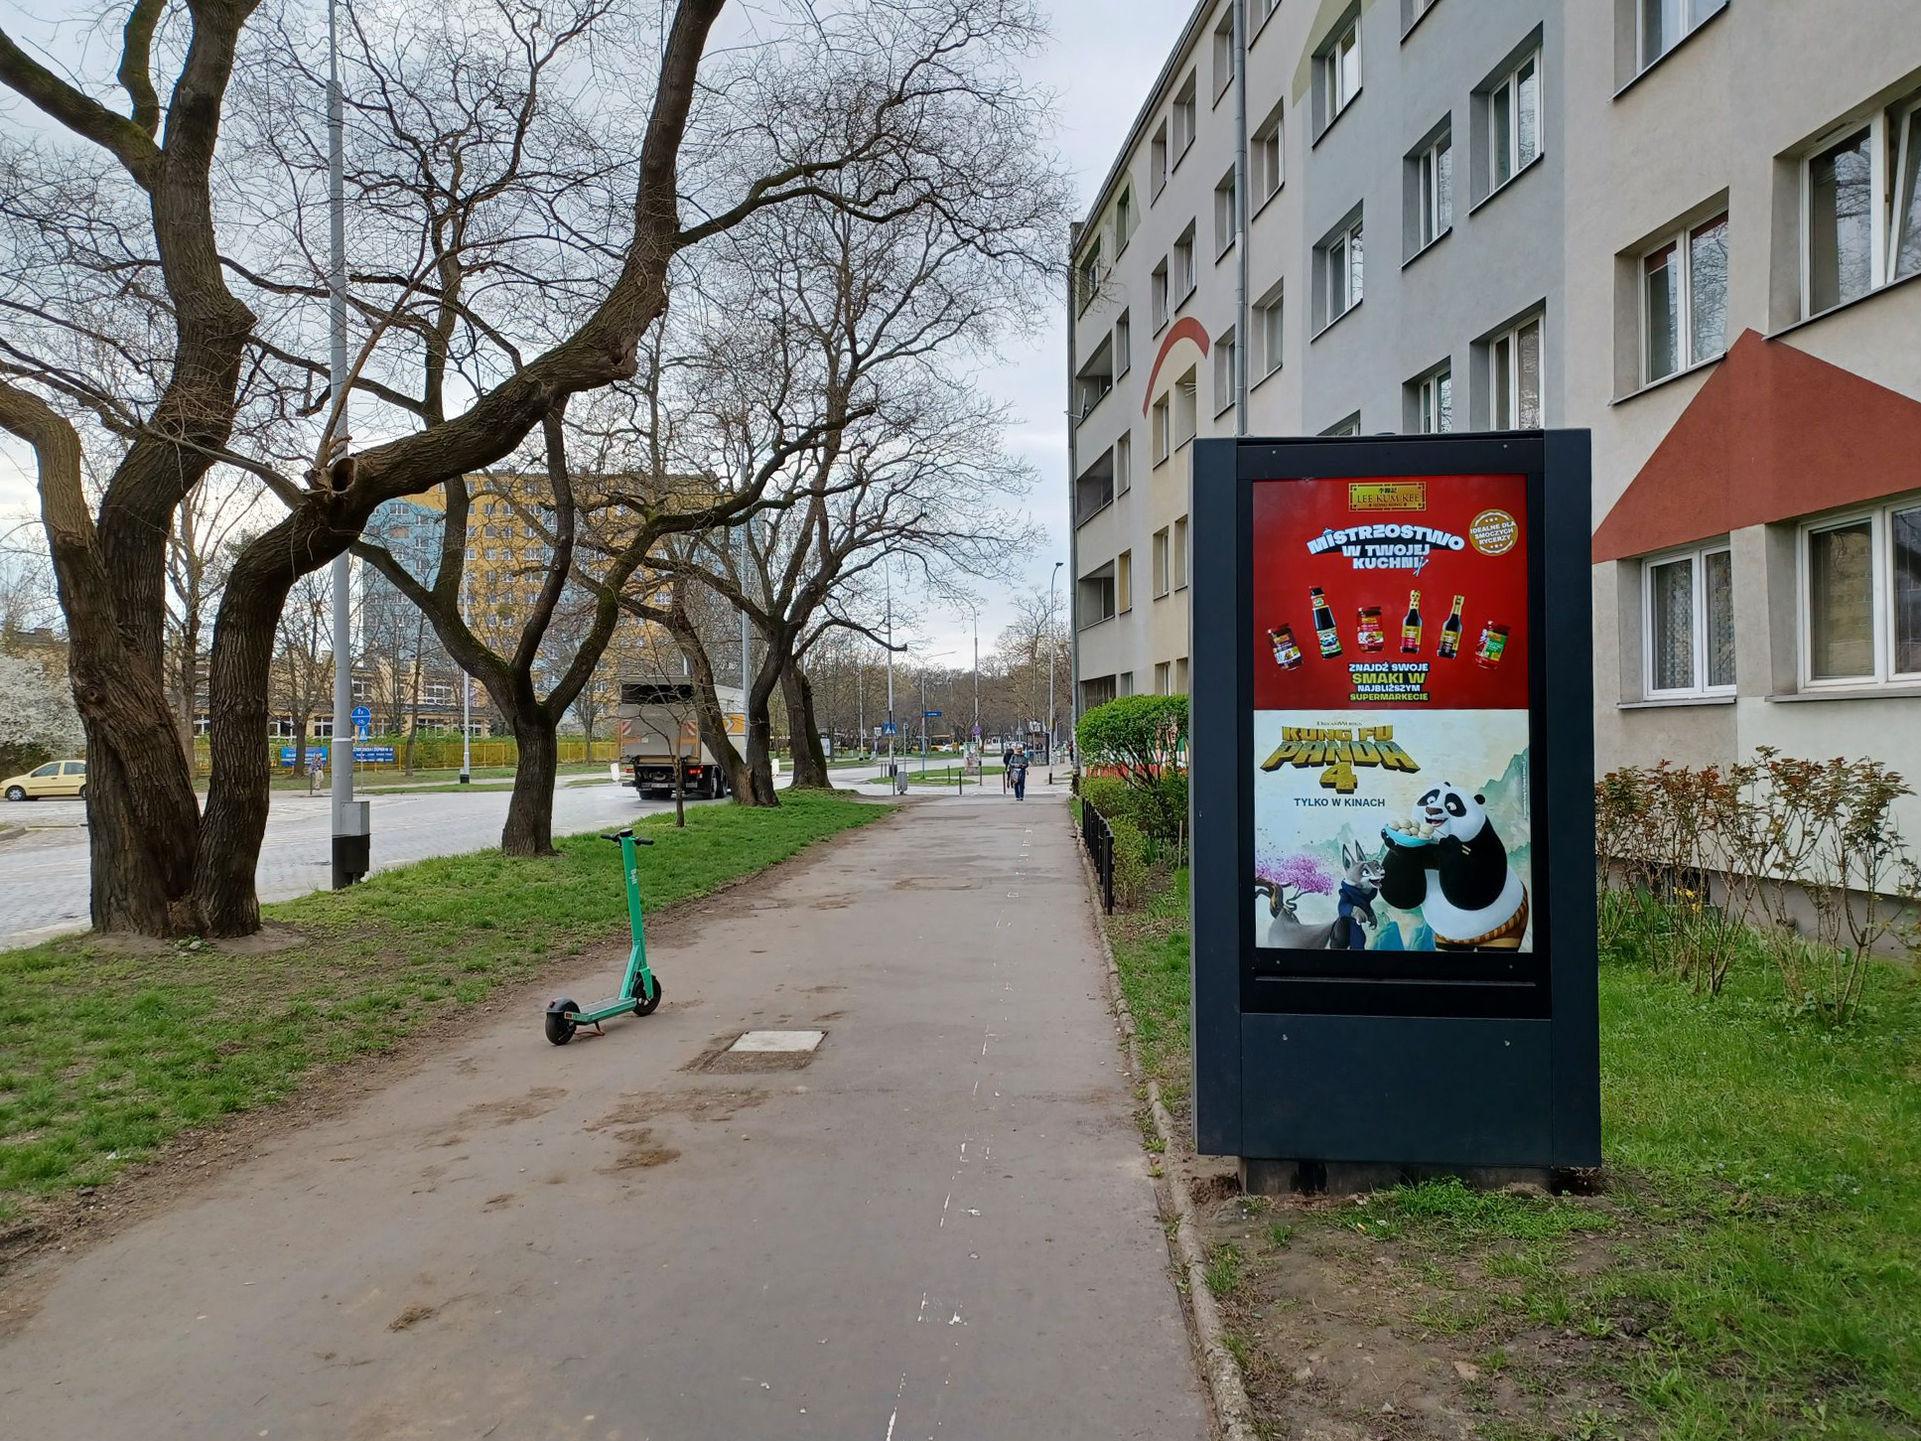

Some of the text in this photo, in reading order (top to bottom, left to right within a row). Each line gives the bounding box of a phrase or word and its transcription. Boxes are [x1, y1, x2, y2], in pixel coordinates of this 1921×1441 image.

[1357, 493, 1420, 503] LEE KUM KEE
[1470, 520, 1517, 534] IDEALNE DLA
[1306, 524, 1465, 555] MISTRZOSTWO
[1475, 527, 1514, 540] SMOCZYCH
[1479, 534, 1511, 545] RYCERZY
[1341, 544, 1430, 557] W TWOJEJ
[1352, 557, 1421, 569] KUCHNI
[1348, 661, 1429, 672] ZNAJDŹ SWOJE
[1352, 672, 1426, 684] SMAKI W
[1357, 683, 1421, 692] NAJBLIŻSZYM
[1350, 692, 1429, 702] SUPERMARKECIE
[1282, 725, 1394, 742] KUNG FU
[1260, 741, 1421, 774] PANDA
[1319, 762, 1358, 795] 4
[1294, 798, 1386, 807] TYLKO W KINACH
